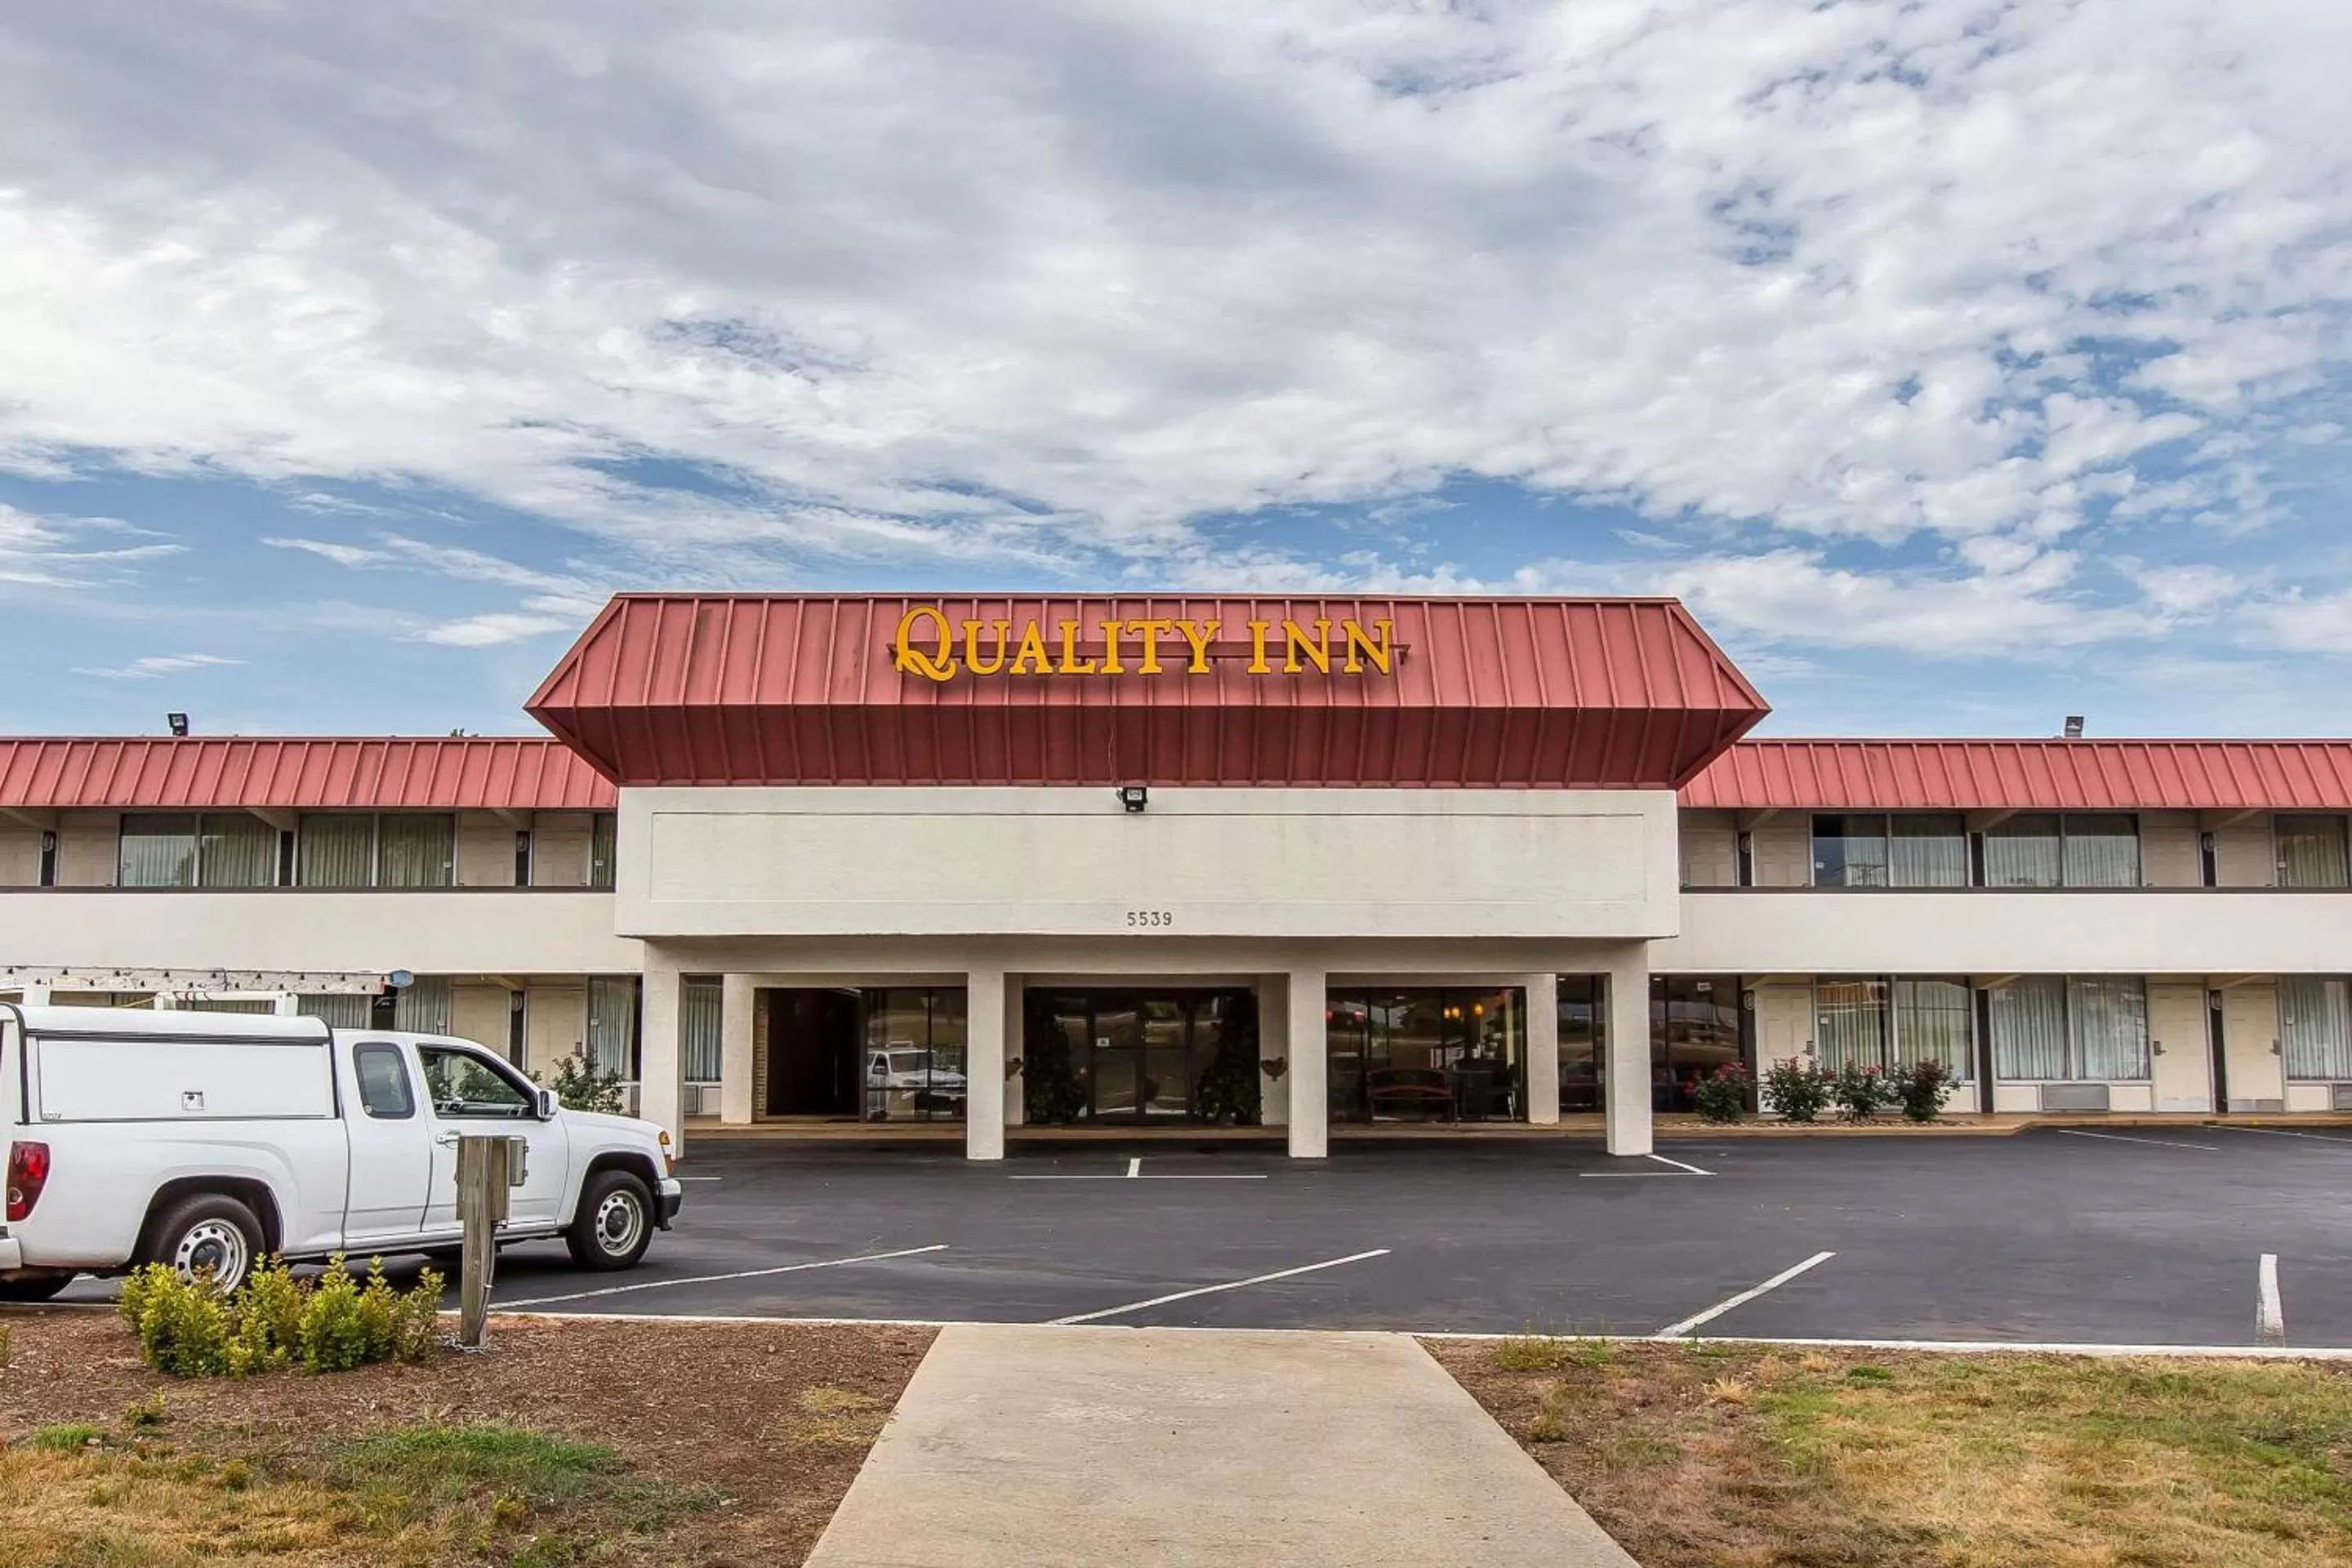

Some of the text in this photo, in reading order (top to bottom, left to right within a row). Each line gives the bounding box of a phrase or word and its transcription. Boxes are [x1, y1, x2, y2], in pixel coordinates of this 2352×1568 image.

[895, 606, 1393, 682] QUALITY INN
[1126, 911, 1173, 926] 5539
